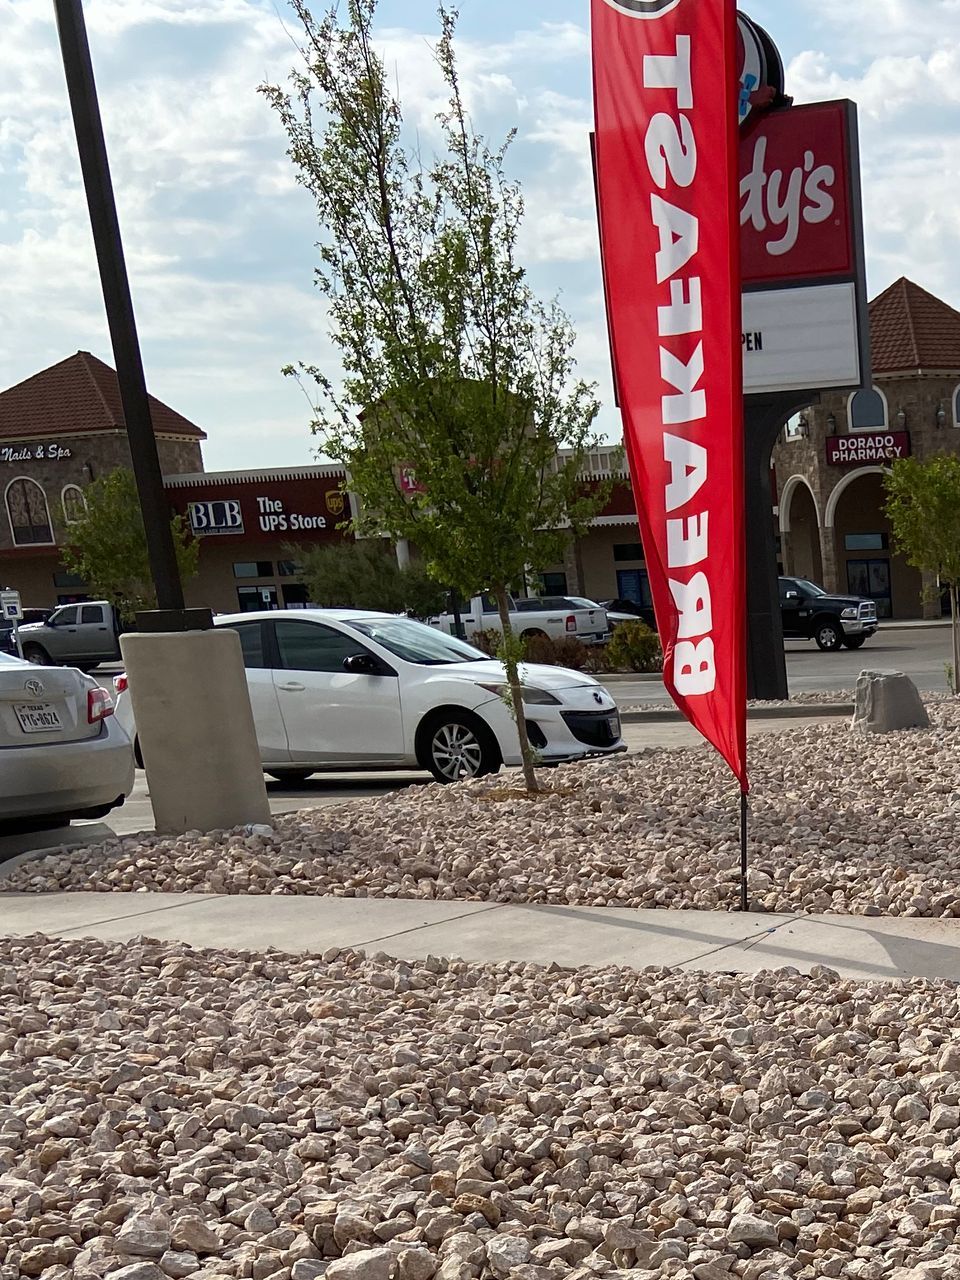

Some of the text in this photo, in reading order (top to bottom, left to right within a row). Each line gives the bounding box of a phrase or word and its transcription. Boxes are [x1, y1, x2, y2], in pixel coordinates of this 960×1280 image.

[838, 435, 894, 450] DORADO
[1, 444, 71, 462] Nails & Spa
[832, 446, 902, 462] PHARMACY
[256, 497, 283, 513] The
[191, 501, 241, 529] BLB
[259, 513, 327, 531] UPS Store
